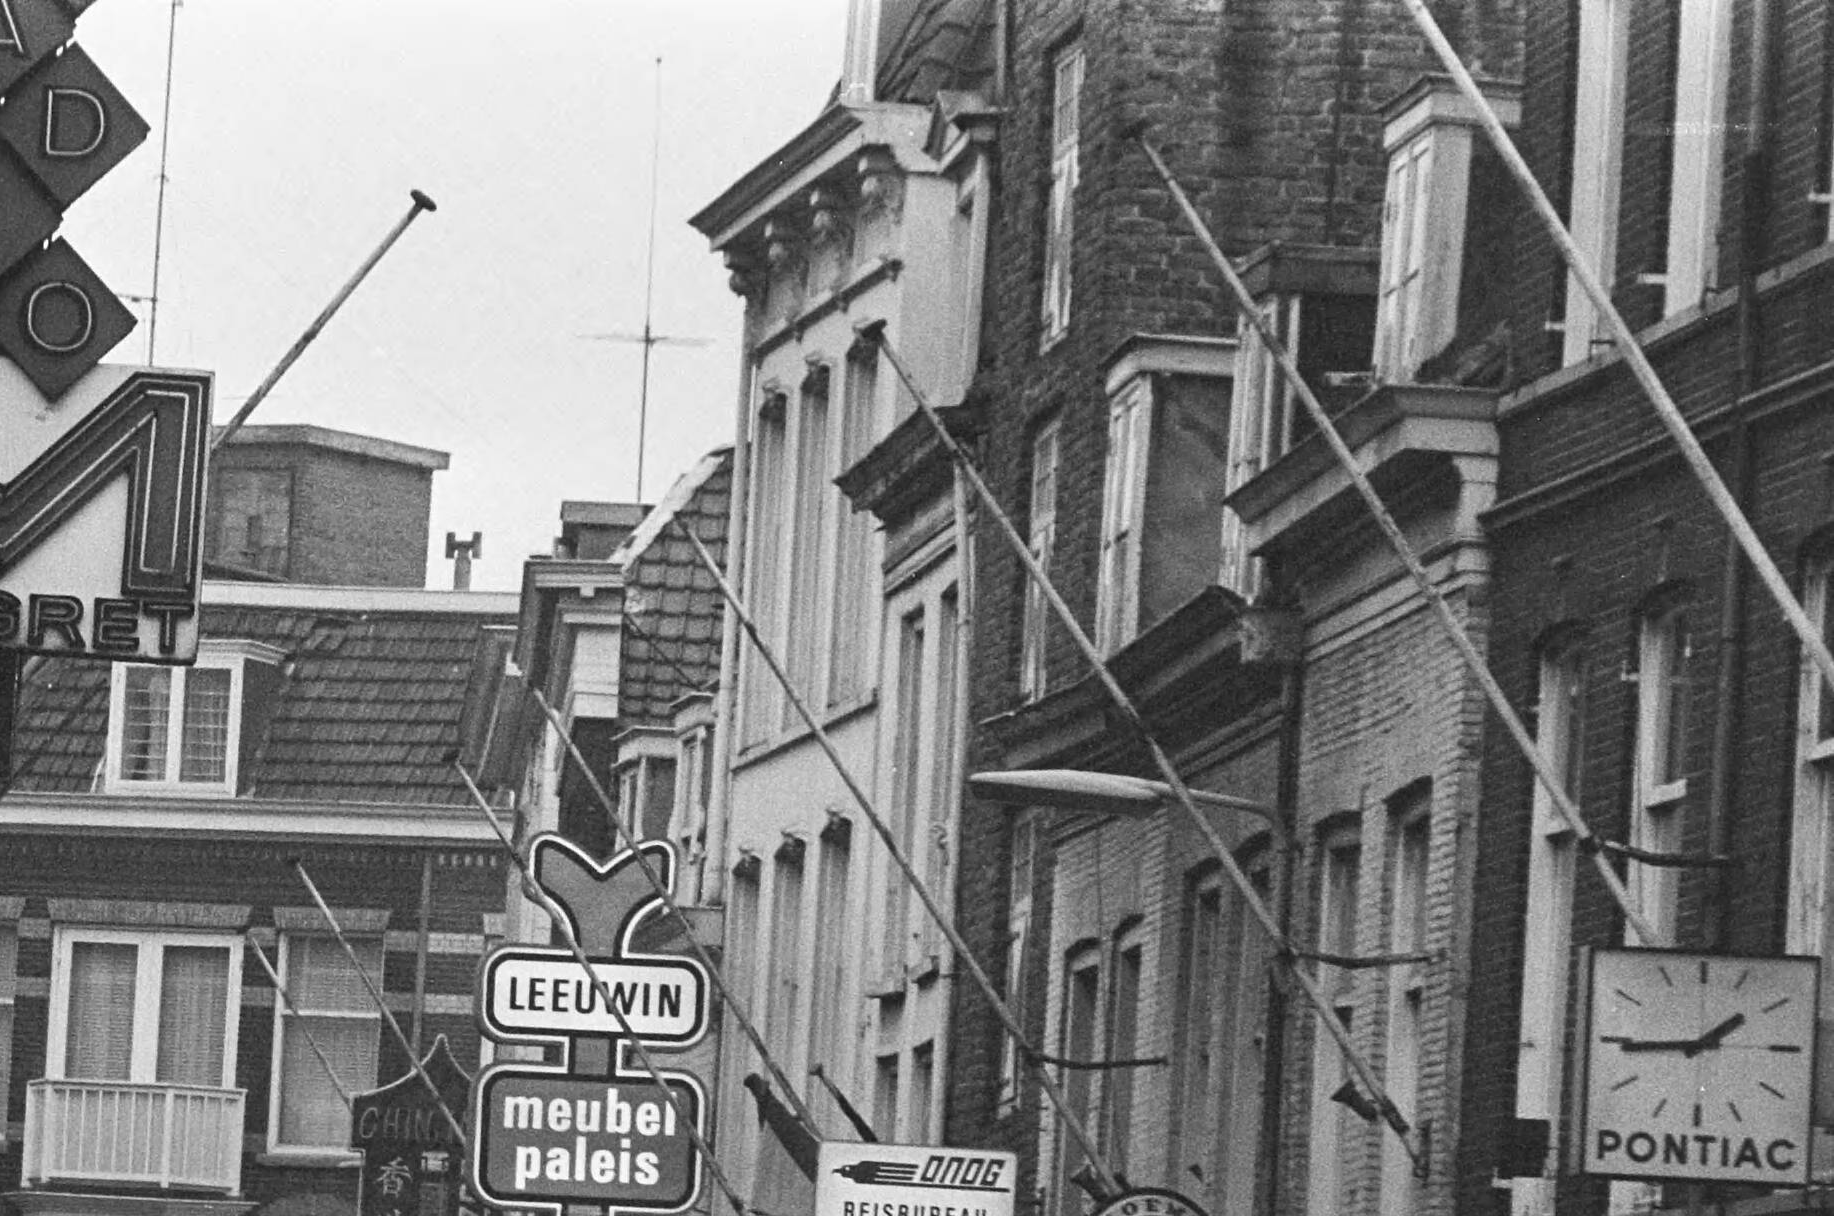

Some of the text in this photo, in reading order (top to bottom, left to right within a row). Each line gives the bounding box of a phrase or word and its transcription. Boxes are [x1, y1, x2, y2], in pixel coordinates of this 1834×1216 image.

[509, 976, 682, 1018] LEEUWIN
[503, 1087, 677, 1137] meubel
[515, 1136, 661, 1190] paleis
[1596, 1129, 1795, 1170] PONTIAC
